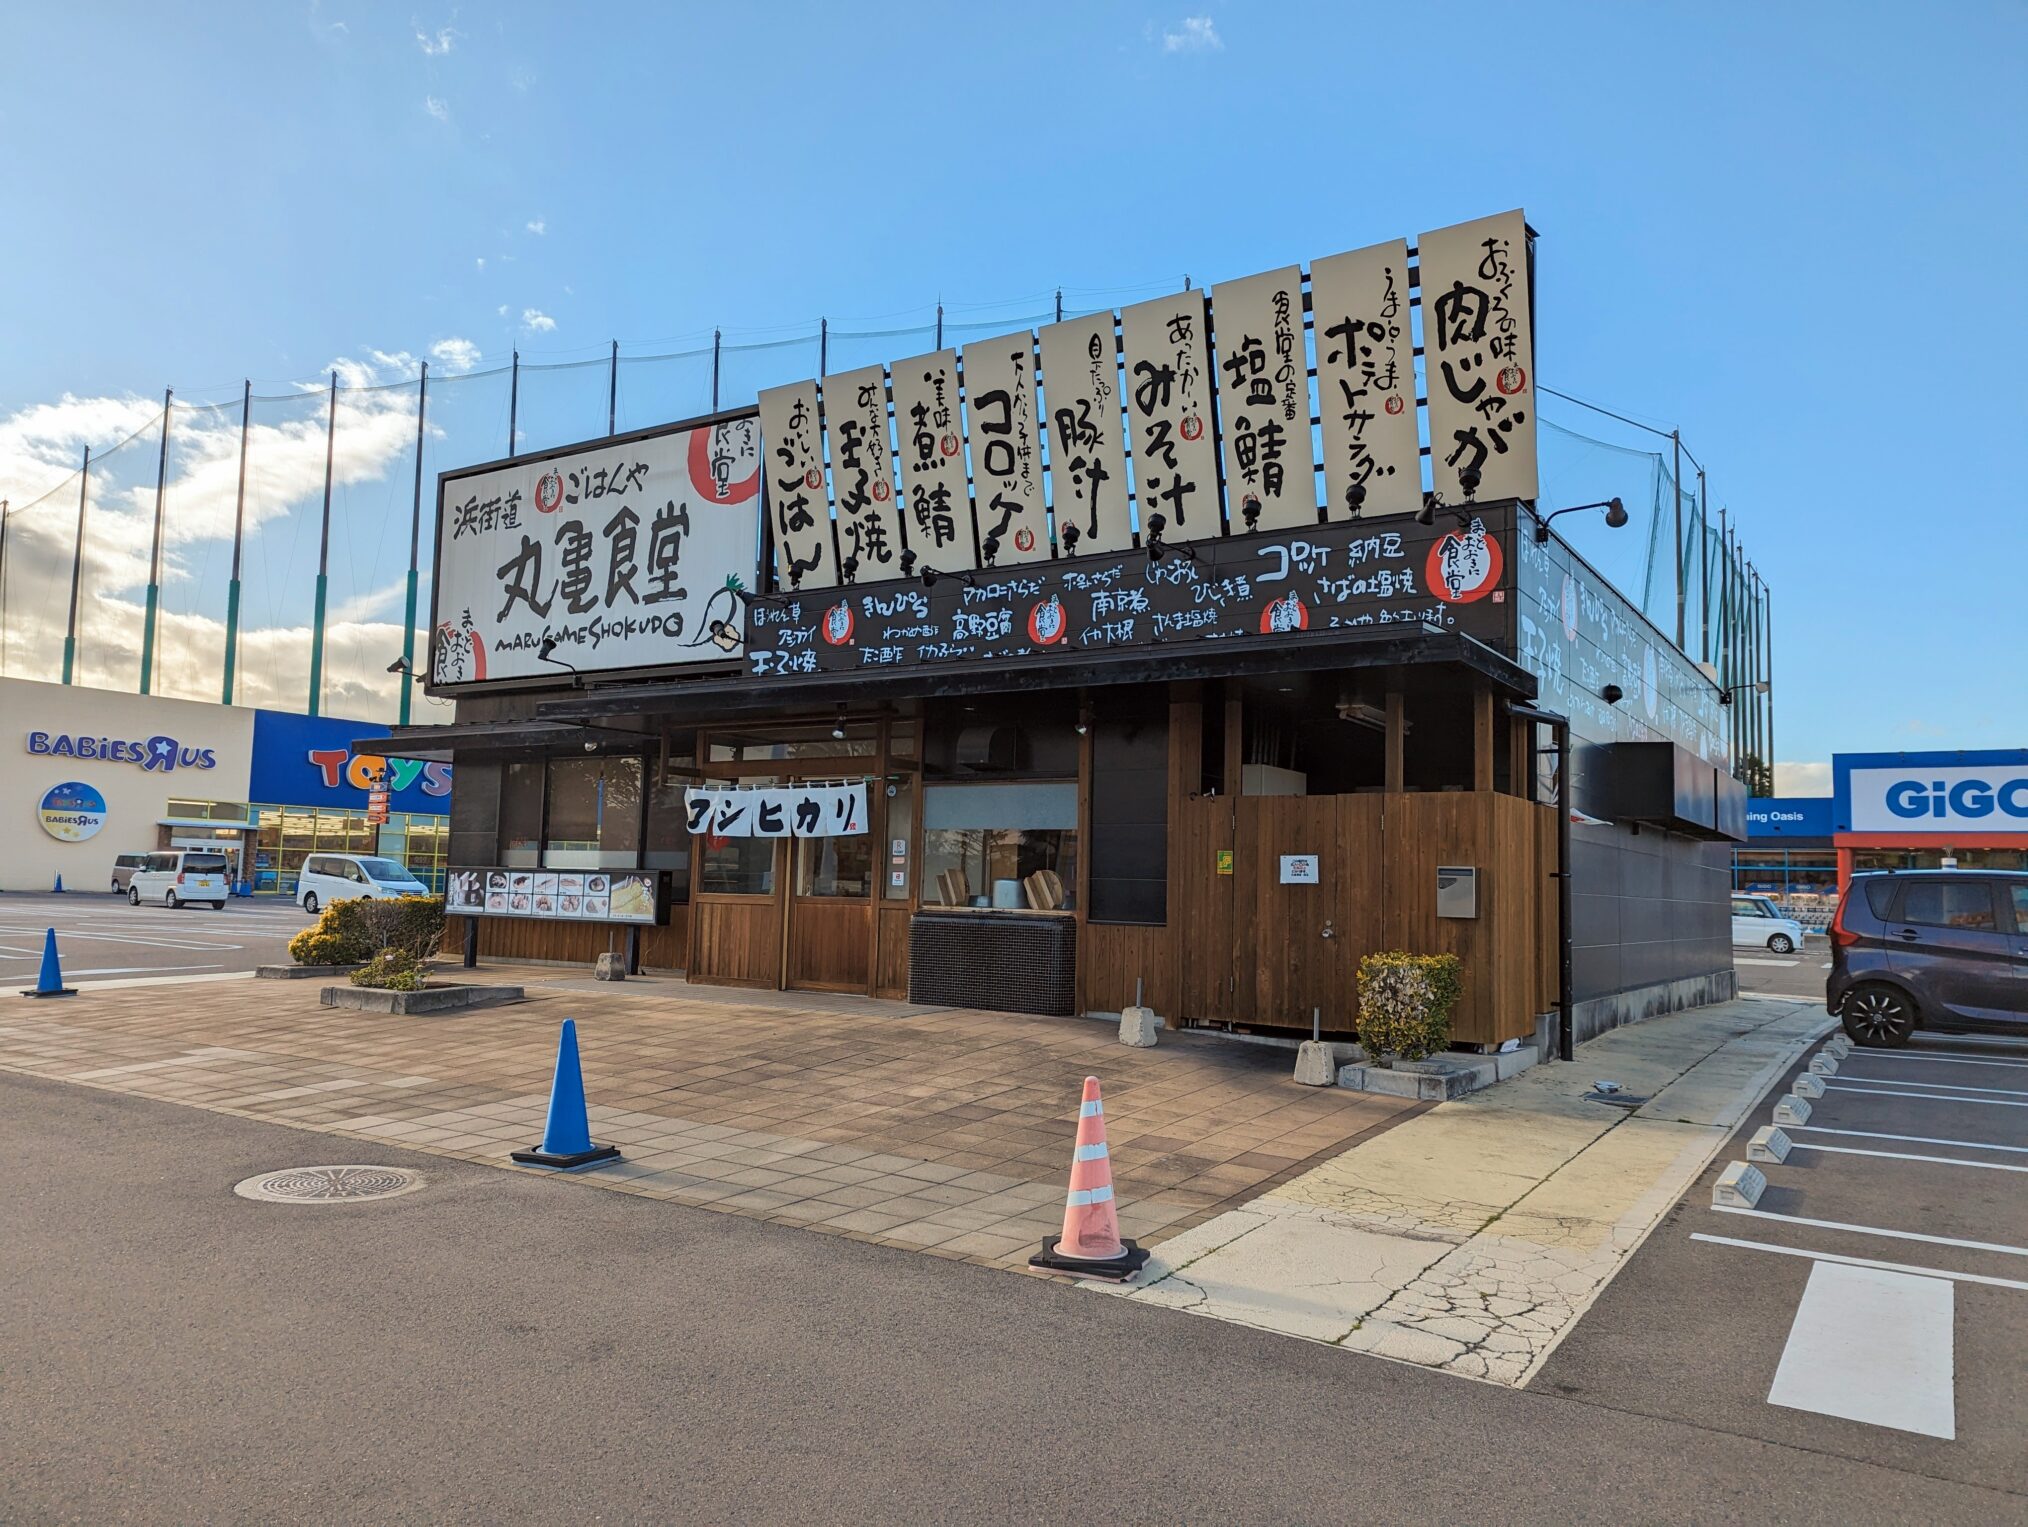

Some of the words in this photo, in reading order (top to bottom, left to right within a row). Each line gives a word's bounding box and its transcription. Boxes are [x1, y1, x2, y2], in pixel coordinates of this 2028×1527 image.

[1477, 236, 1517, 362] おふくろの味
[1271, 290, 1298, 421] 食堂の定番
[1434, 279, 1526, 472] 肉じゃが
[789, 398, 815, 468] おいしい
[924, 369, 951, 432] 美味
[1222, 334, 1287, 498] 塩鯖
[911, 400, 955, 548] 煮鯖
[973, 390, 1024, 538] コロッケ
[1055, 398, 1110, 540] 豚汁
[1133, 359, 1196, 526] みそ汁
[453, 488, 522, 540] 浜街道
[565, 462, 650, 504] ごはんや
[776, 436, 822, 573] ごはん
[840, 420, 892, 564] 玉子焼
[496, 500, 691, 623] 丸亀食堂
[1256, 541, 1331, 582] コロッケ
[1348, 532, 1405, 568] 納豆
[1438, 533, 1466, 599] 食堂
[863, 591, 929, 619] きんぴら
[962, 576, 1046, 606] マカロニさらだ
[1314, 567, 1418, 605] さばの塩焼
[952, 607, 1014, 641] 高野豆腐
[1771, 811, 1804, 821] Oasis
